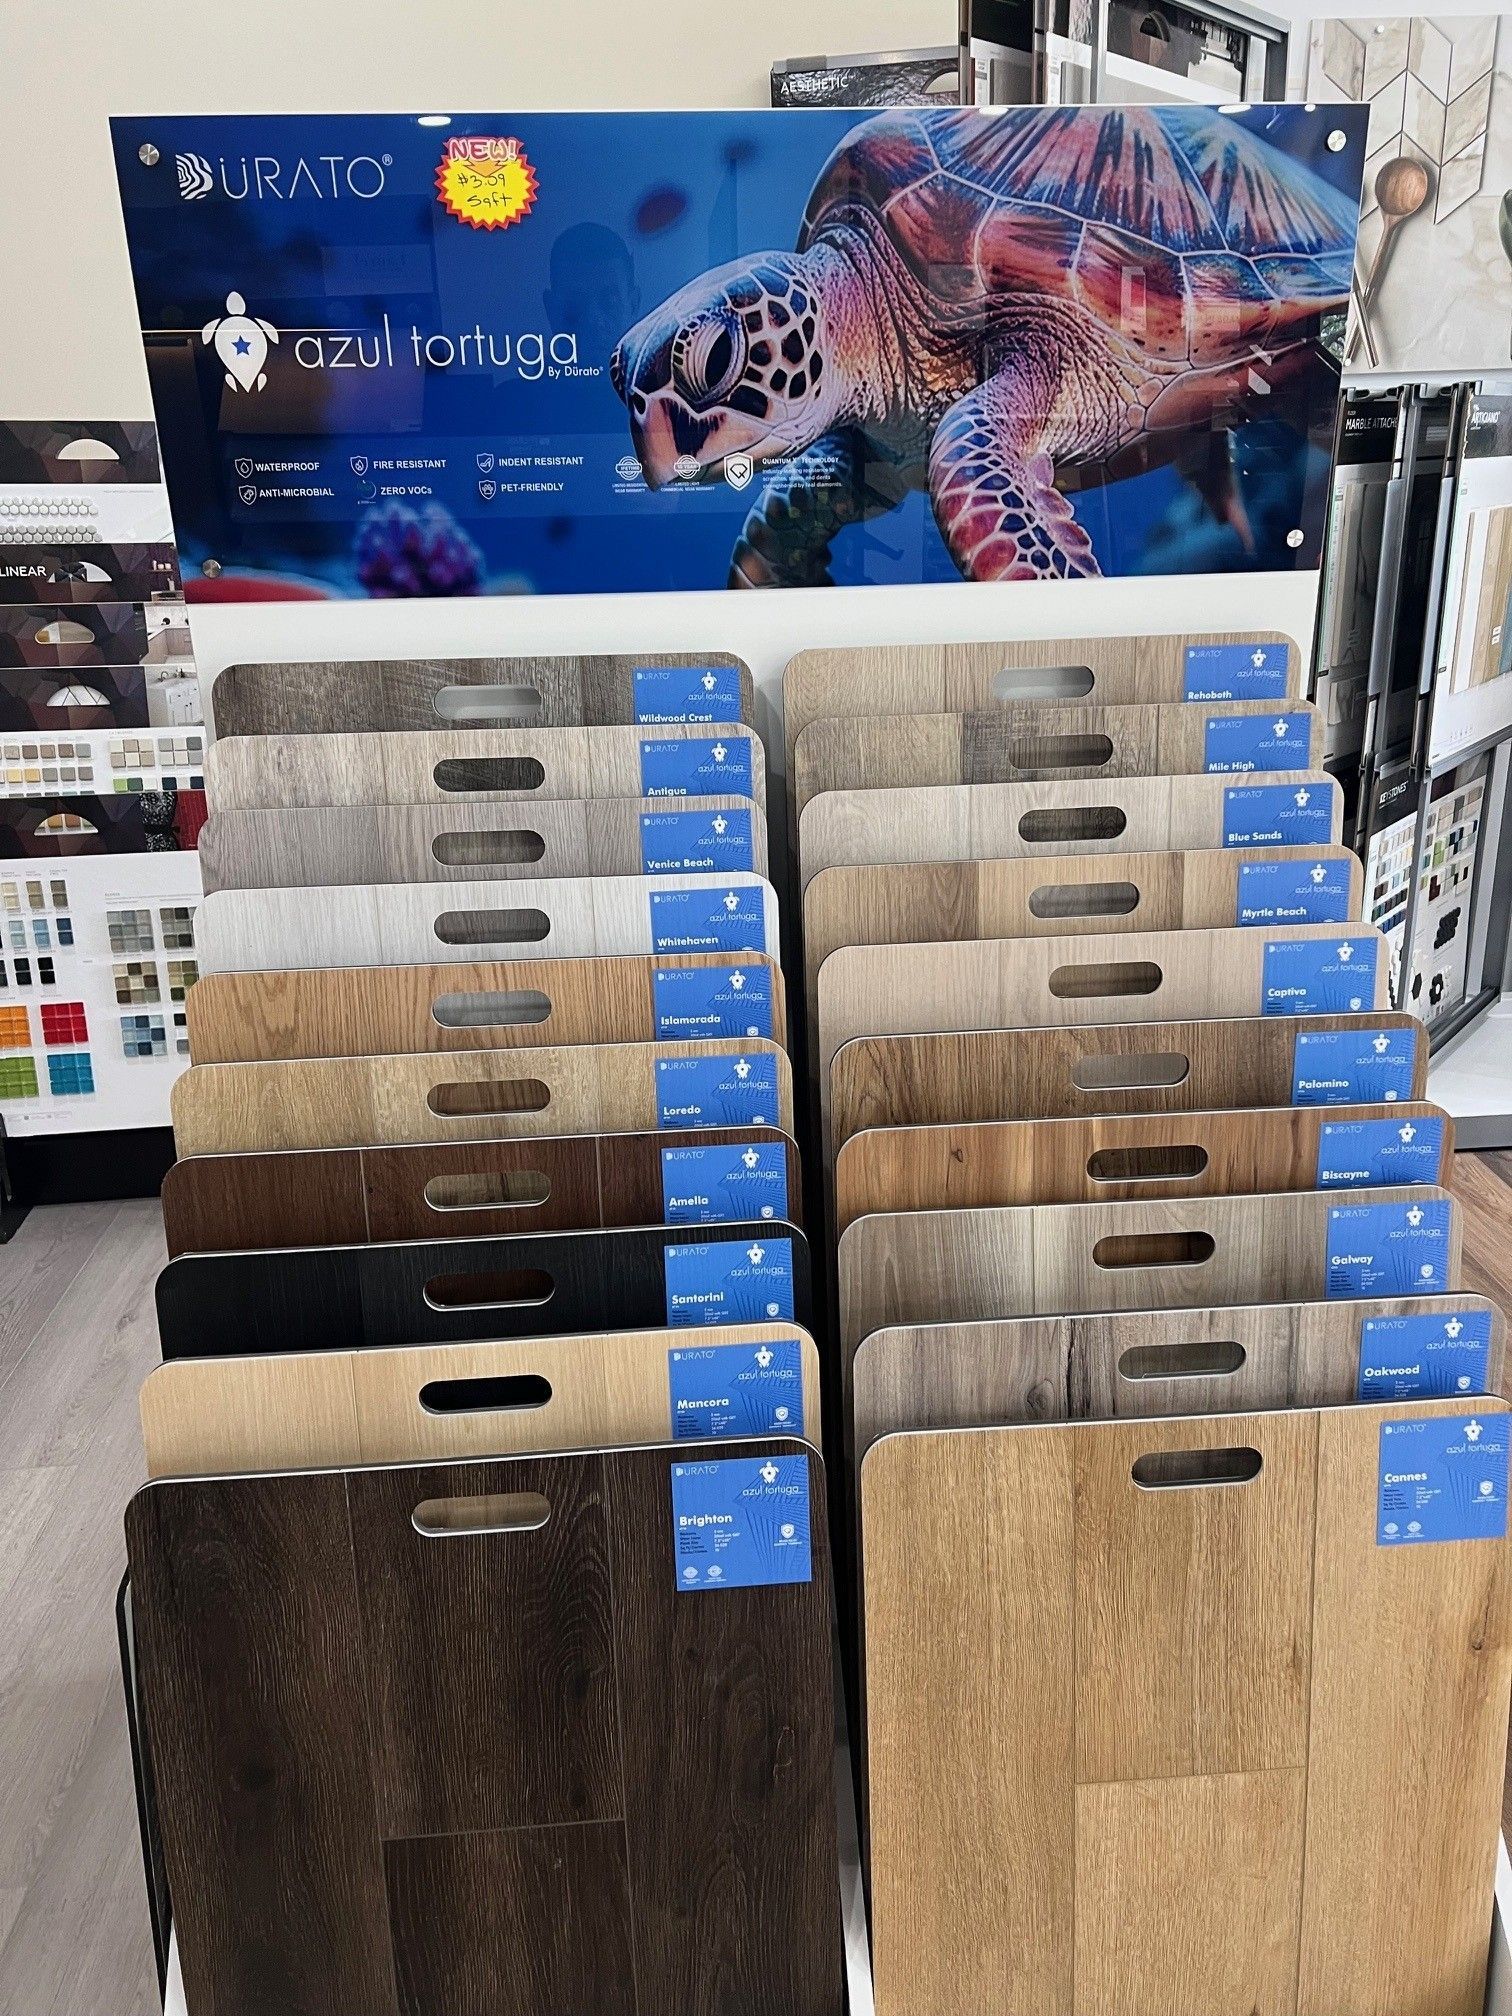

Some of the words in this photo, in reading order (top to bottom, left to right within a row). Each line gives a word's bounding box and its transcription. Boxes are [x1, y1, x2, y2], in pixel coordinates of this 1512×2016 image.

[780, 76, 849, 94] AESTHETIC
[449, 138, 518, 162] NEW!
[294, 313, 394, 368] azul
[411, 324, 578, 380] tortuga
[548, 366, 561, 380] By
[1345, 418, 1372, 430] MARBLE
[373, 460, 395, 470] FIRE
[396, 459, 447, 469] RESISTANT
[498, 458, 534, 467] INDENT
[534, 456, 584, 466] RESISTANT
[254, 462, 320, 472] WATERPROOF
[380, 486, 405, 496] ZERO
[407, 486, 432, 495] VOCs
[501, 482, 564, 492] PET-FRIENDLY
[259, 488, 335, 498] ANTI-MICROBIAL
[1237, 669, 1253, 678] azul
[1254, 670, 1280, 678] tortuga
[706, 693, 732, 702] tortuga
[1188, 691, 1232, 700] Rehoboth
[639, 714, 686, 722] Wildwood
[688, 714, 712, 722] Crest
[1259, 740, 1275, 748] azul
[1276, 740, 1302, 748] tortuga
[715, 764, 744, 773] tortuga
[1208, 762, 1230, 771] Mile
[1232, 761, 1254, 770] High
[648, 787, 686, 796] Antigua
[1280, 810, 1296, 818] azul
[1298, 810, 1325, 818] tortuga
[698, 836, 714, 844] azul
[716, 836, 744, 845] tortuga
[1228, 833, 1250, 842] Blue
[1252, 831, 1282, 840] Sands
[647, 860, 680, 868] Venice
[684, 858, 714, 867] Beach
[1295, 885, 1312, 894] azul
[1314, 886, 1342, 894] tortuga
[710, 914, 726, 922] azul
[728, 913, 757, 922] tortuga
[1242, 908, 1274, 918] Myrtle
[1276, 907, 1306, 916] Beach
[657, 936, 718, 946] Whitehaven
[1322, 964, 1339, 972] azul
[1340, 964, 1368, 972] tortuga
[714, 992, 732, 1000] azul
[733, 992, 762, 1002] tortuga
[1268, 988, 1306, 998] Captiva
[661, 1014, 720, 1025] Islamorada
[1356, 1055, 1374, 1064] azul
[1376, 1056, 1406, 1064] tortuga
[719, 1081, 736, 1090] azul
[738, 1080, 769, 1090] tortuga
[1298, 1079, 1350, 1089] Palomino
[664, 1105, 700, 1116] Loredo
[1382, 1146, 1400, 1154] azul
[1401, 1145, 1432, 1154] tortuga
[726, 1171, 745, 1180] azul
[746, 1170, 778, 1180] tortuga
[1322, 1170, 1370, 1180] Biscayne
[669, 1196, 709, 1206] Amelia
[1390, 1229, 1408, 1238] azul
[1410, 1228, 1440, 1238] tortuga
[1332, 1255, 1374, 1266] Galway
[731, 1267, 750, 1276] azul
[752, 1266, 784, 1276] tortuga
[672, 1292, 724, 1304] Santorini
[1426, 1340, 1446, 1350] azul
[1448, 1340, 1480, 1350] tortuga
[738, 1370, 758, 1380] azul
[760, 1369, 792, 1380] tortuga
[1364, 1364, 1420, 1377] Oakwood
[678, 1398, 730, 1410] Mancora
[1446, 1443, 1466, 1454] azul
[1468, 1444, 1500, 1454] tortuga
[1384, 1472, 1428, 1483] Cannes
[742, 1486, 762, 1496] azul
[766, 1485, 799, 1496] tortuga
[680, 1514, 732, 1526] Brighton
